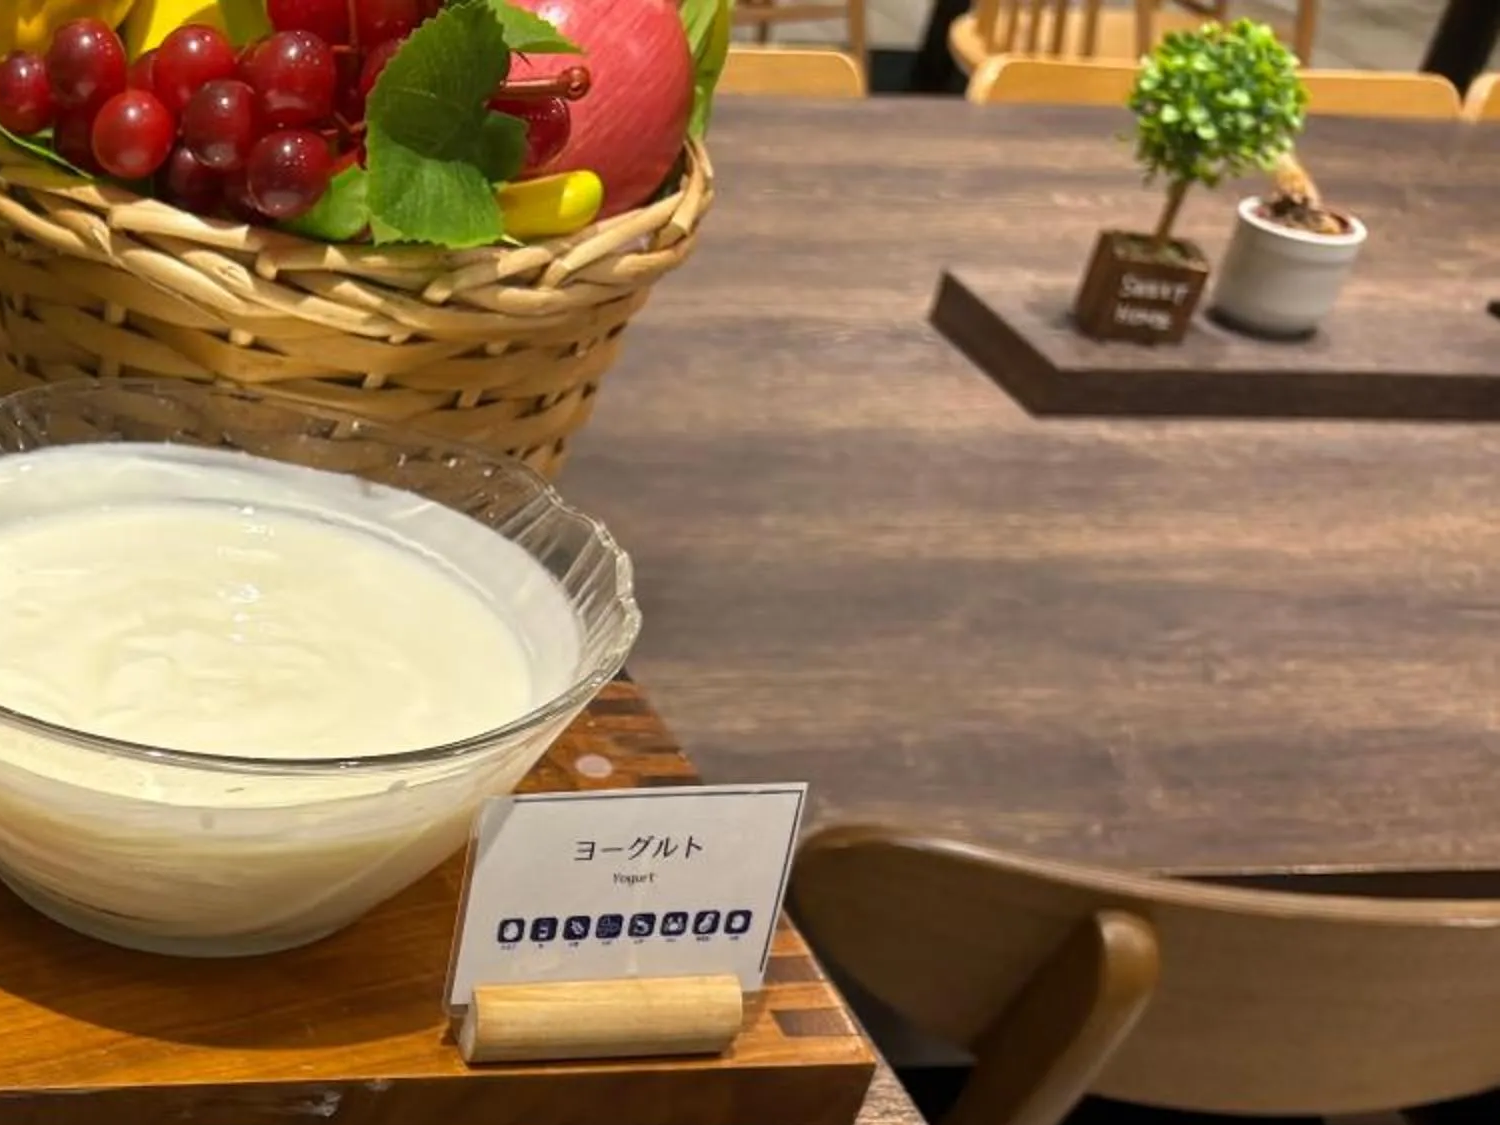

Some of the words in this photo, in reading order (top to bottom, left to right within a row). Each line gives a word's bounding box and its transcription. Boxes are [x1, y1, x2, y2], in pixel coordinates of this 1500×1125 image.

[573, 835, 704, 862] ヨーグルト
[612, 871, 656, 886] Yogurt
